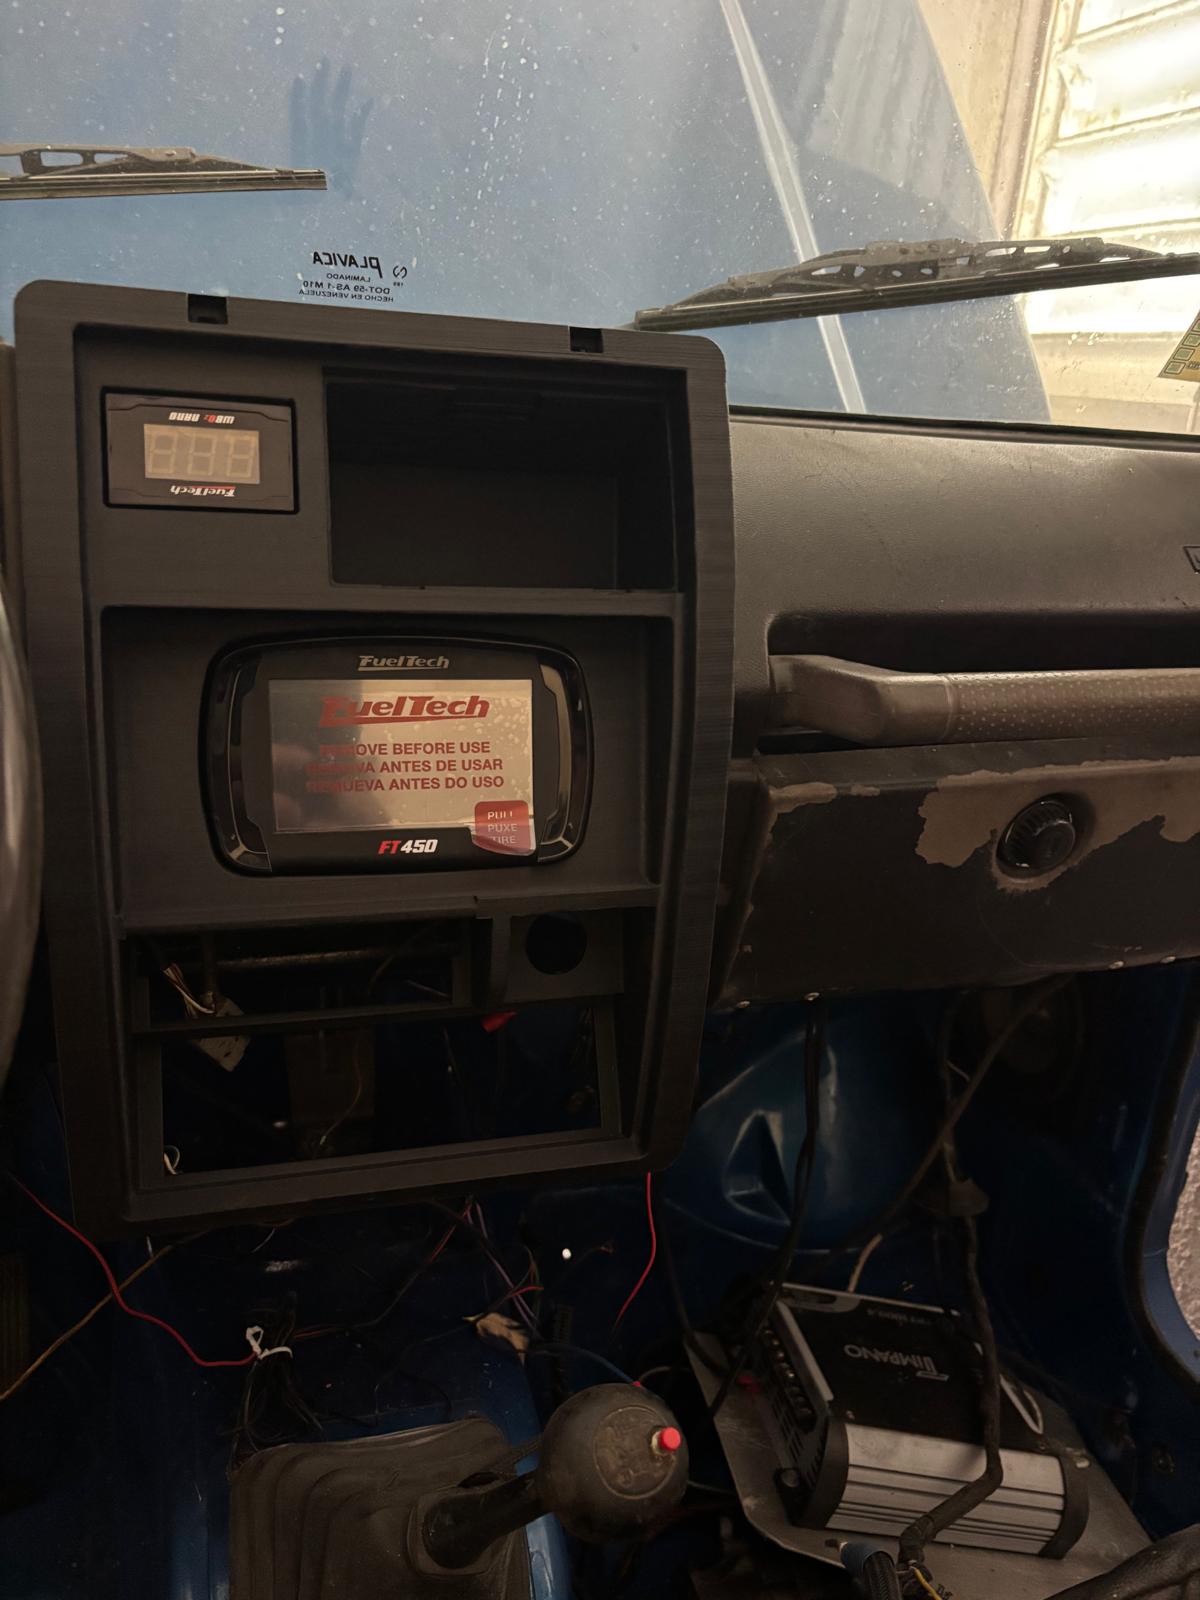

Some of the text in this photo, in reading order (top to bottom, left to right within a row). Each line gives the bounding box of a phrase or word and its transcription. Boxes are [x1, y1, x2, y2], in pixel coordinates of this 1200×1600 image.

[170, 485, 236, 497] FuelTech
[358, 655, 450, 672] FuelTech
[319, 695, 490, 727] FuelTech
[320, 741, 491, 757] OVE BEFORE USE
[380, 760, 432, 774] ANTES
[436, 759, 457, 772] DE
[461, 758, 504, 772] USAR
[305, 775, 505, 793] UEVA ANTES DO USO
[487, 823, 518, 833] PUXE
[377, 838, 439, 855] FT450
[843, 1344, 950, 1382] TIMPANO
